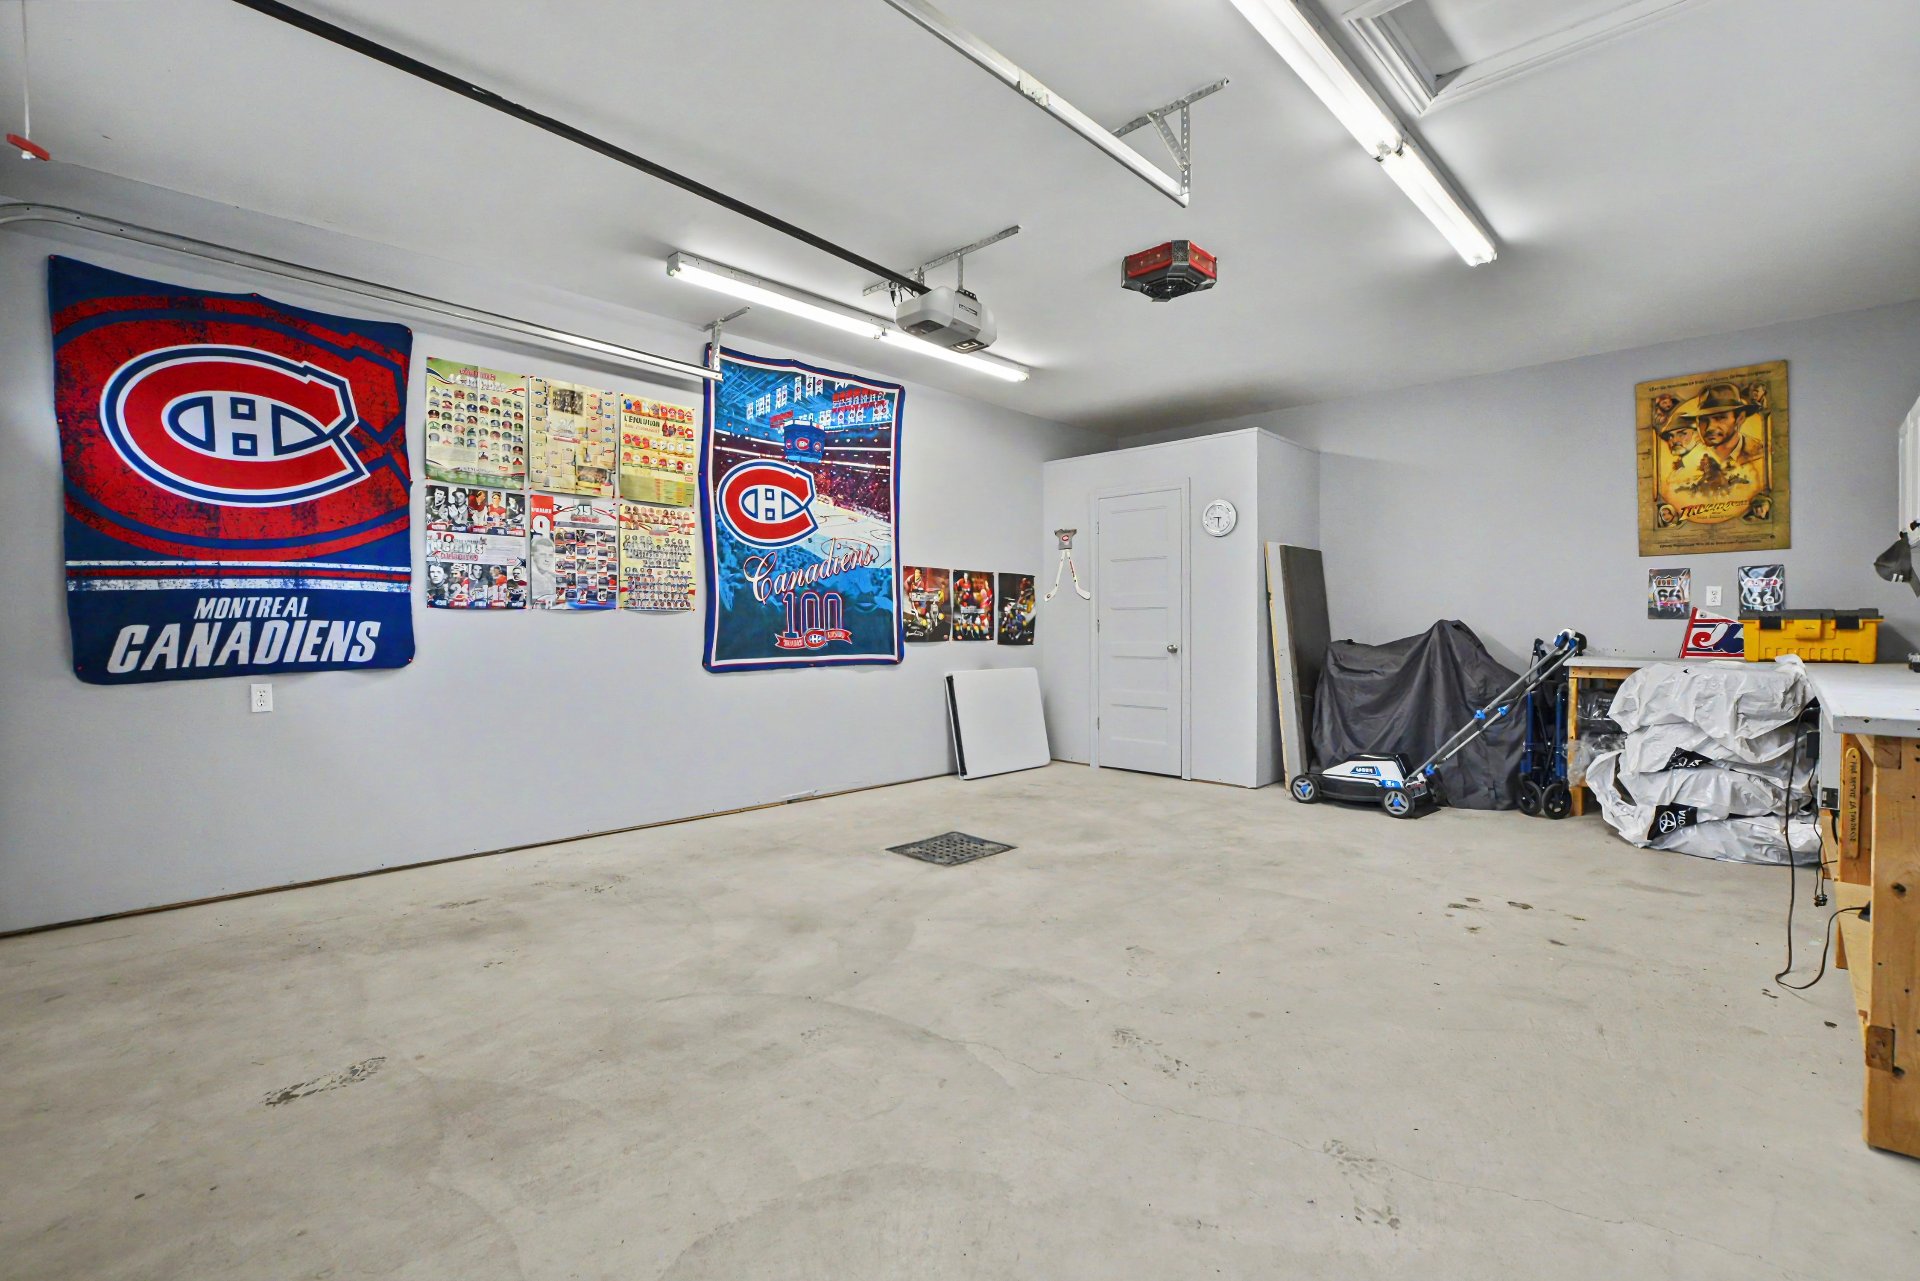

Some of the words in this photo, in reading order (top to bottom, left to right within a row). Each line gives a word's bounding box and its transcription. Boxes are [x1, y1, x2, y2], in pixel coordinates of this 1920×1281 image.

[743, 538, 874, 605] Canadiens
[194, 596, 309, 620] MONTREAL
[783, 591, 844, 638] 100
[106, 621, 381, 674] CANADIENS
